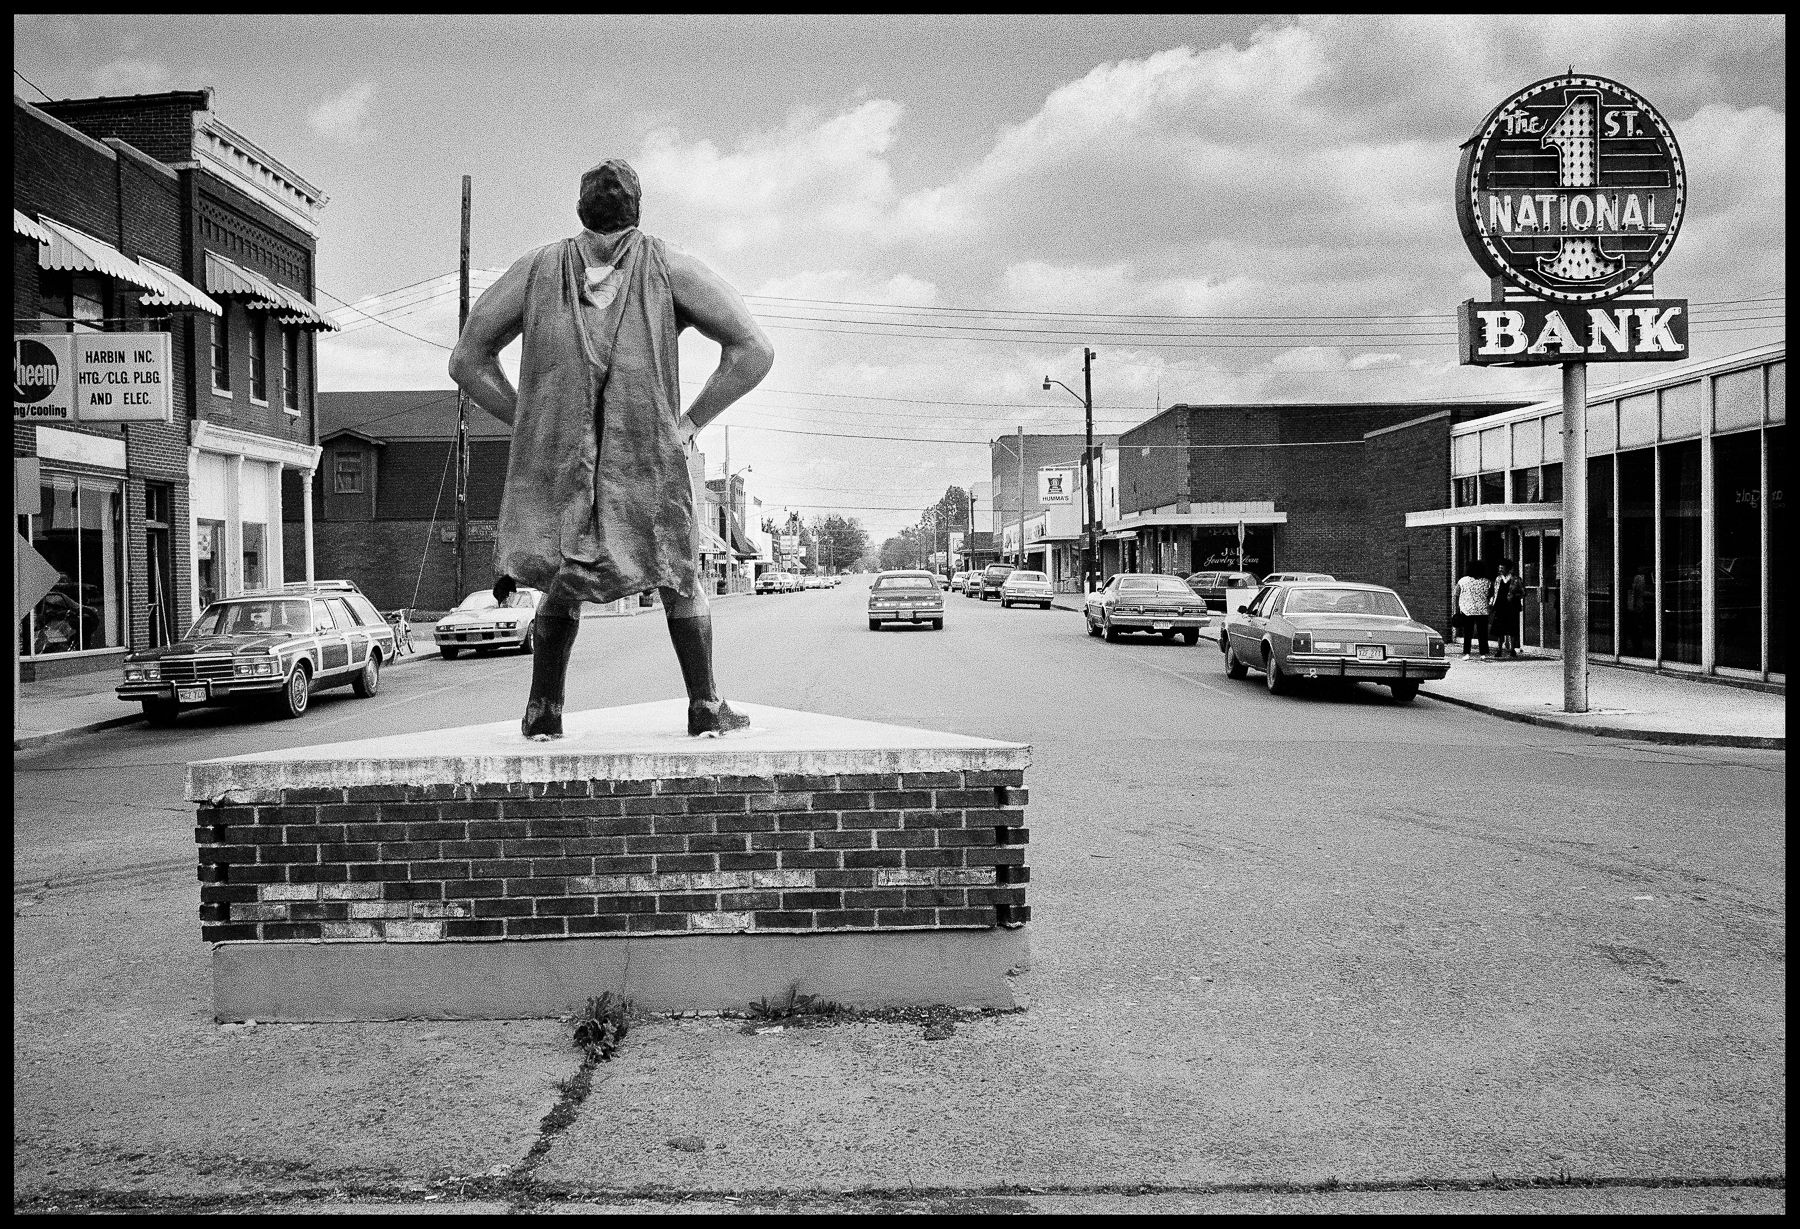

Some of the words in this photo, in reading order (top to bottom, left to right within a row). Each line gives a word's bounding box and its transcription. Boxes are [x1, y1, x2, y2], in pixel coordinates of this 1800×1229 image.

[1503, 109, 1549, 136] The
[1604, 110, 1644, 137] ST.
[1489, 193, 1667, 234] NATIONAL
[1477, 307, 1685, 355] BANK
[14, 341, 57, 395] heem
[85, 350, 125, 363] HARBIN
[134, 350, 155, 363] INC.
[134, 371, 162, 384] PLBG.
[90, 392, 112, 405] AND
[123, 392, 152, 405] ELEC.
